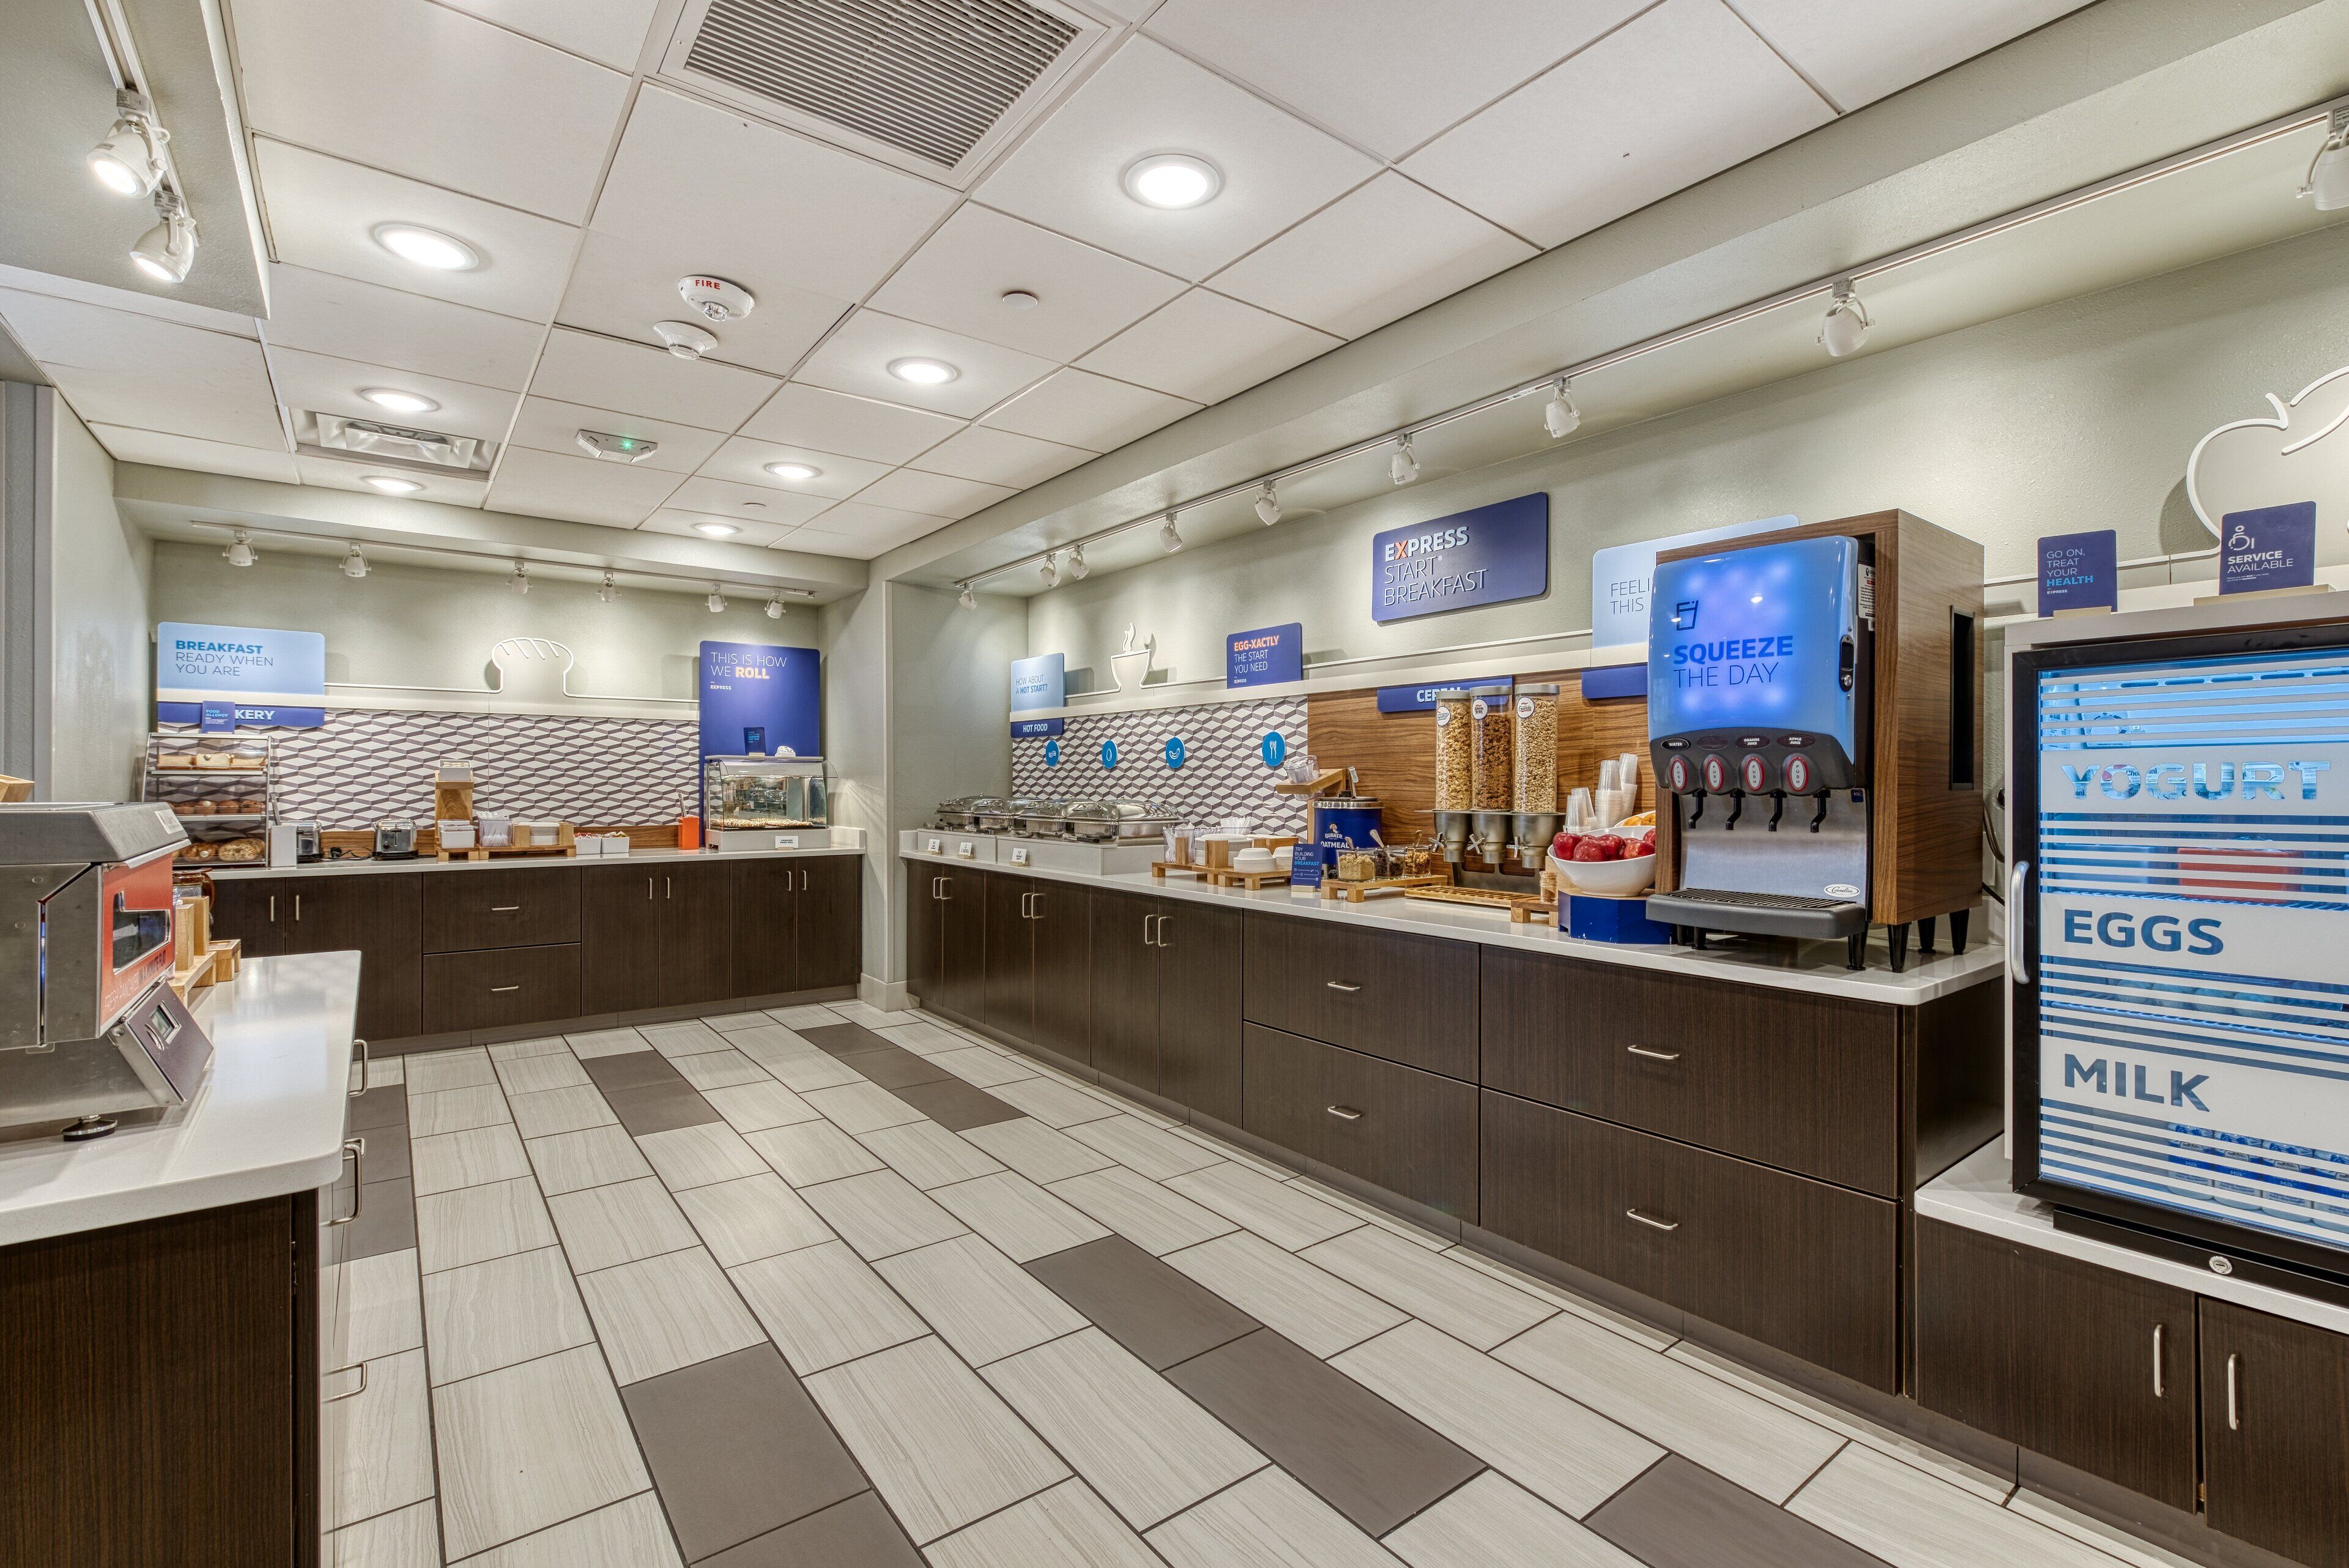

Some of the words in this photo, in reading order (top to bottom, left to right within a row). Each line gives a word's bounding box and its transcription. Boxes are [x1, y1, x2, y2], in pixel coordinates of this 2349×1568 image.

[695, 279, 721, 290] FIRE
[1385, 526, 1469, 562] EXPRESS
[2046, 550, 2063, 559] GO
[2066, 548, 2085, 557] ON,
[2227, 550, 2282, 565] SERVICE
[2046, 557, 2079, 568] TREAT
[2227, 558, 2294, 574] AVAILABLE
[2046, 568, 2077, 577] YOUR
[1384, 569, 1488, 606] BREAKFAST
[1611, 578, 1650, 597] FEELI
[2046, 575, 2093, 587] HEALTH
[1610, 597, 1644, 615] THIS
[176, 640, 263, 654] BREAKFAST
[1234, 635, 1279, 652] EGG-XACTLY
[1673, 635, 1793, 664] SQUEEZE
[176, 652, 225, 663] READY
[230, 655, 273, 666] WHEN
[711, 652, 738, 664] THIS
[743, 654, 752, 665] IS
[757, 655, 787, 667] HOW
[1234, 653, 1247, 663] THE
[1249, 649, 1269, 661] START
[176, 663, 207, 675] YOU
[212, 666, 240, 676] ARE
[711, 665, 731, 677] WE
[735, 667, 770, 679] ROLL
[1234, 664, 1248, 674] YOU
[1250, 661, 1268, 672] NEED
[1673, 666, 1718, 688] THE
[1729, 661, 1779, 685] DAY
[1015, 677, 1028, 686] HOW
[1028, 674, 1044, 684] ABOUT
[1031, 683, 1048, 693] START?
[1417, 686, 1461, 702] CER
[235, 709, 275, 721] KERY
[1023, 724, 1033, 733] HOT
[1034, 723, 1048, 732] FOOD
[2060, 760, 2331, 800] YOGURT
[2064, 908, 2224, 956] EGGS
[2064, 1053, 2210, 1112] MILK
